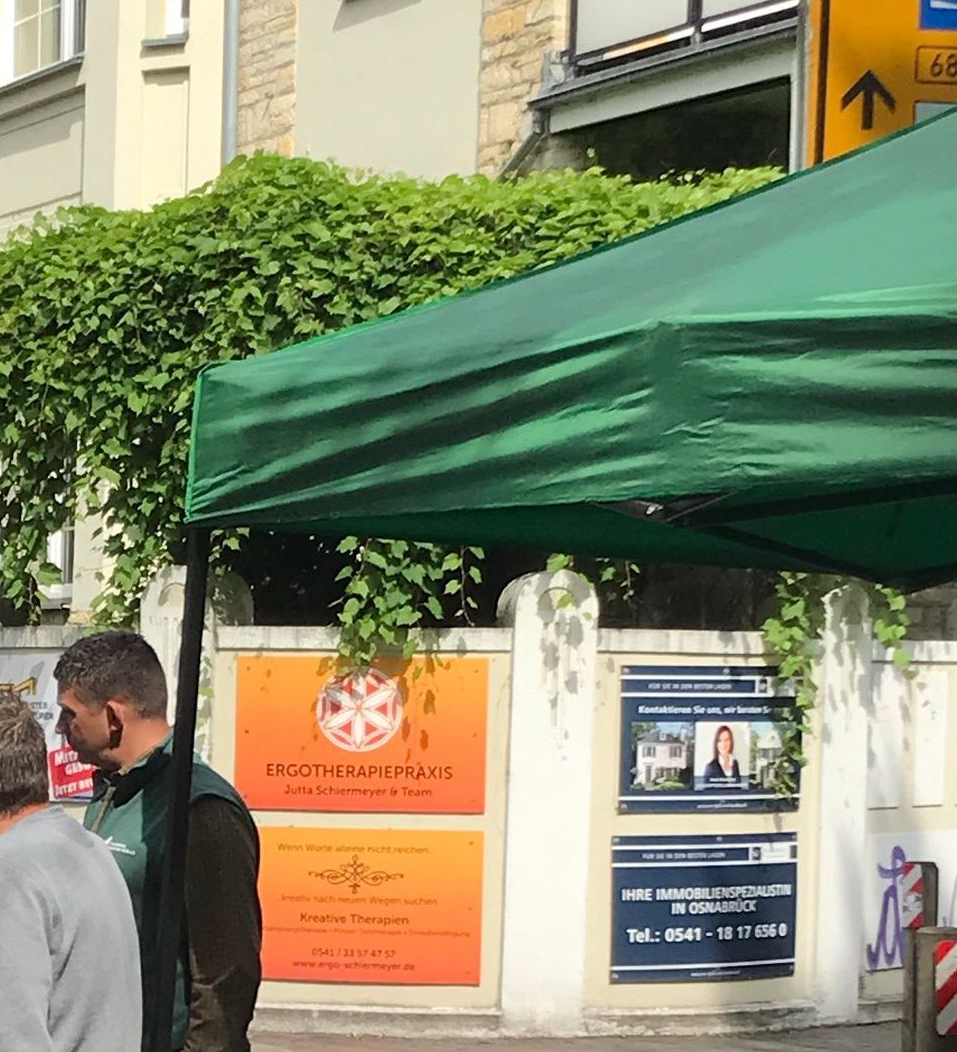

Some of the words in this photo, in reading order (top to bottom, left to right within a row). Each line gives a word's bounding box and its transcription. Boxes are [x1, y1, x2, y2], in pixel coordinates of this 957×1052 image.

[638, 705, 692, 714] Kontaktieren
[266, 763, 453, 780] ERGOTHERAPIEPRAXIS
[284, 784, 313, 795] Jutta
[316, 785, 387, 798] Schiermeyer
[389, 786, 397, 797] &
[401, 786, 432, 797] Team
[621, 888, 653, 901] IHRE
[656, 884, 792, 901] IMMOBILIENSPEZIALISTIN
[671, 902, 686, 915] IN
[688, 897, 758, 915] OSNABRÜCK
[300, 912, 347, 924] Kreative
[350, 913, 409, 926] Therapien
[626, 927, 661, 944] Tel.:
[664, 927, 702, 943] 0541
[716, 926, 733, 940] 18
[736, 925, 752, 939] 17
